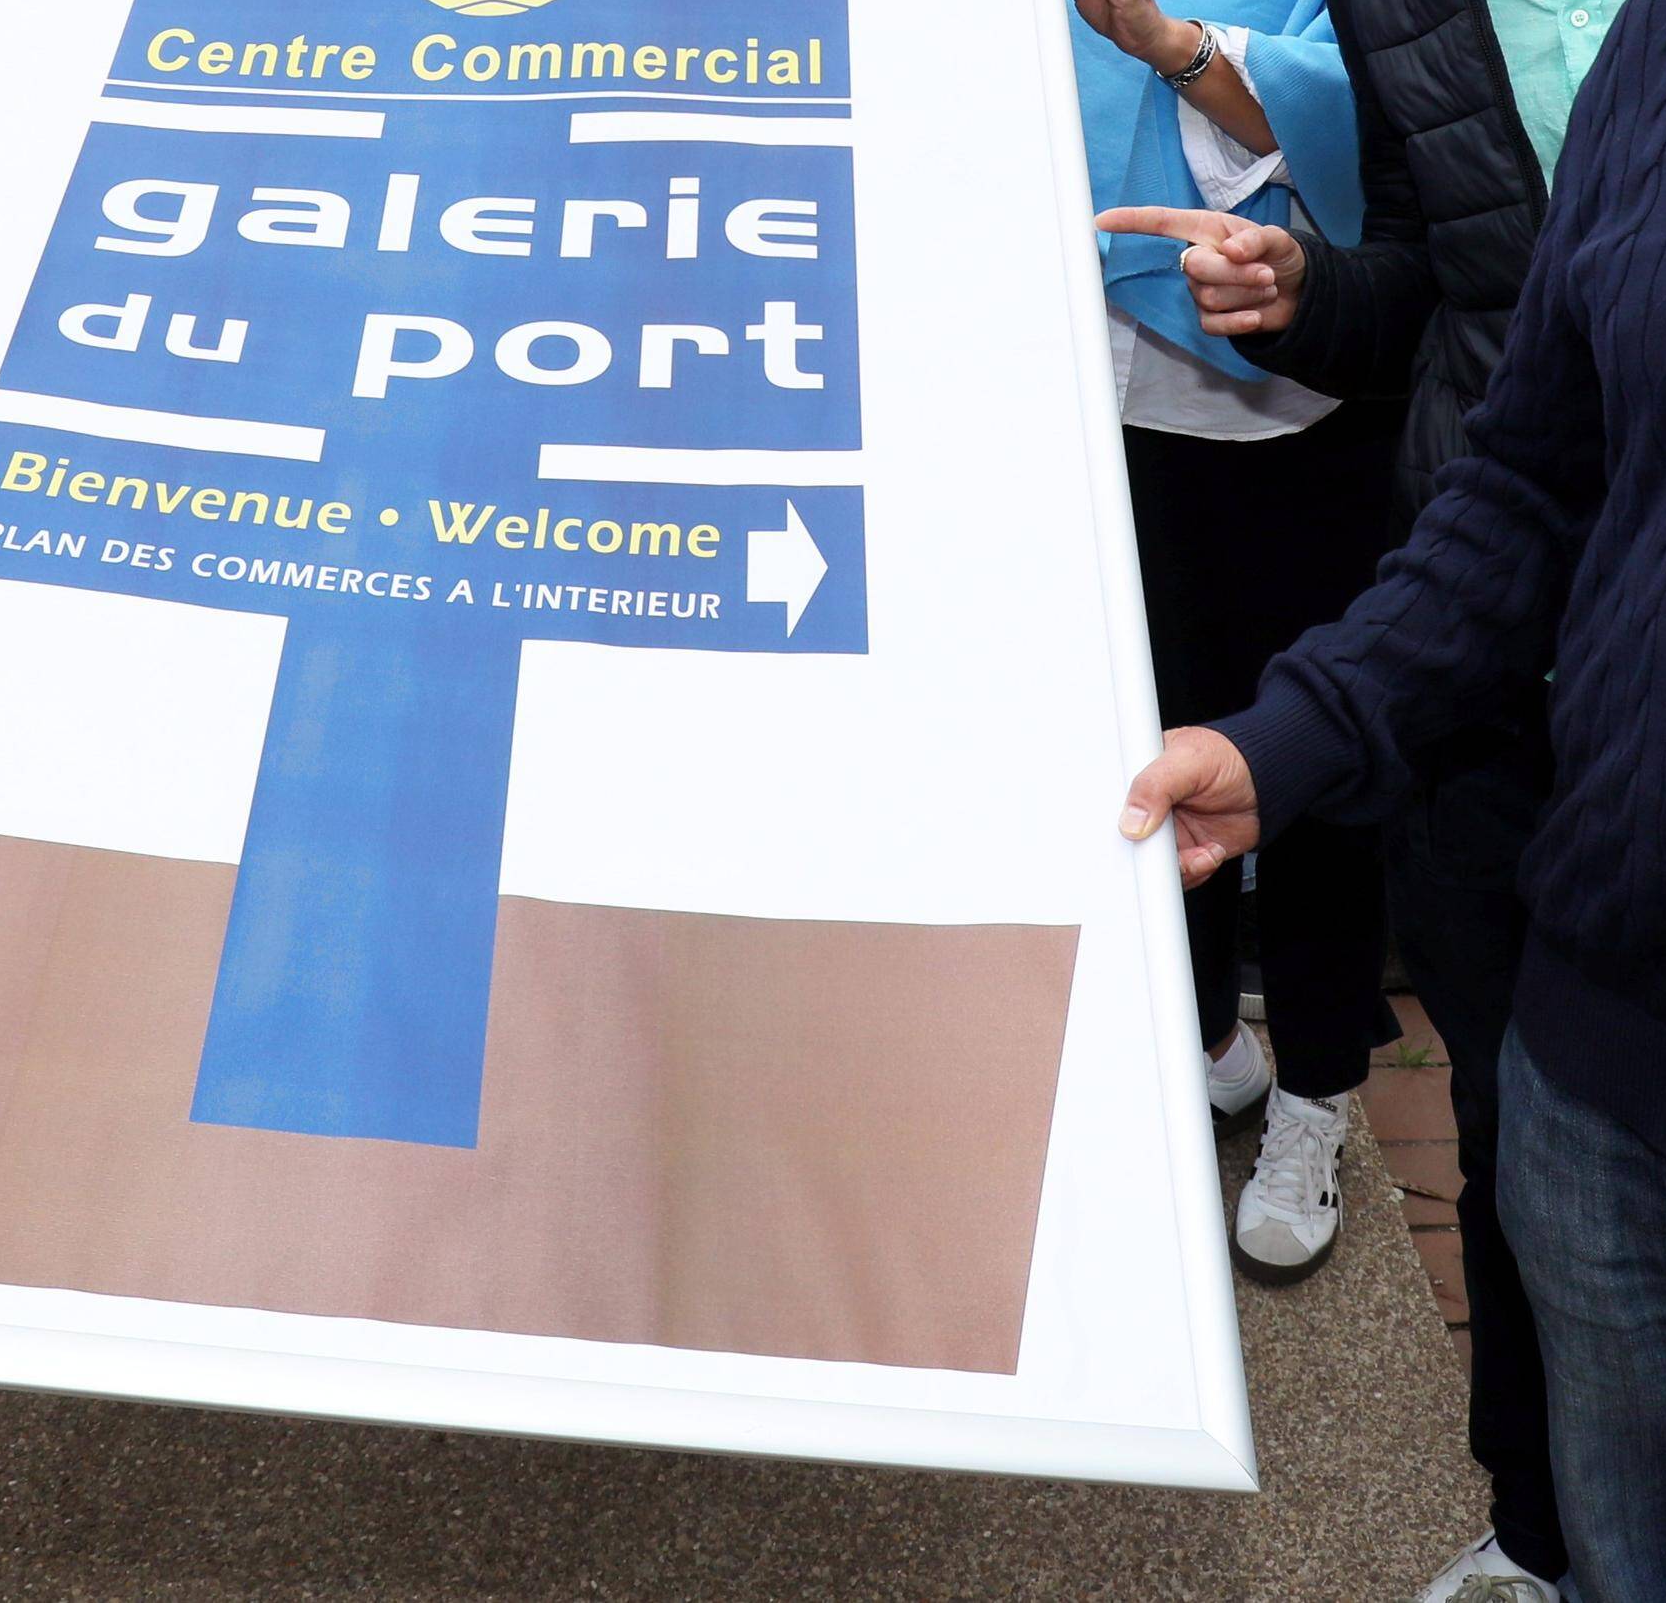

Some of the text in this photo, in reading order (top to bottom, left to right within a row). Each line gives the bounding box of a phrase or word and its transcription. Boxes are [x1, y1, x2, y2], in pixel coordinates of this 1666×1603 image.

[146, 27, 823, 86] Centre Commercial
[93, 172, 820, 260] galerie
[57, 292, 824, 399] du port
[0, 450, 721, 558] Bienvenue Welcome
[100, 538, 176, 571] DES
[191, 552, 433, 601] COMMERCES
[445, 579, 474, 605] A
[491, 582, 721, 619] L'INTERIEUR
